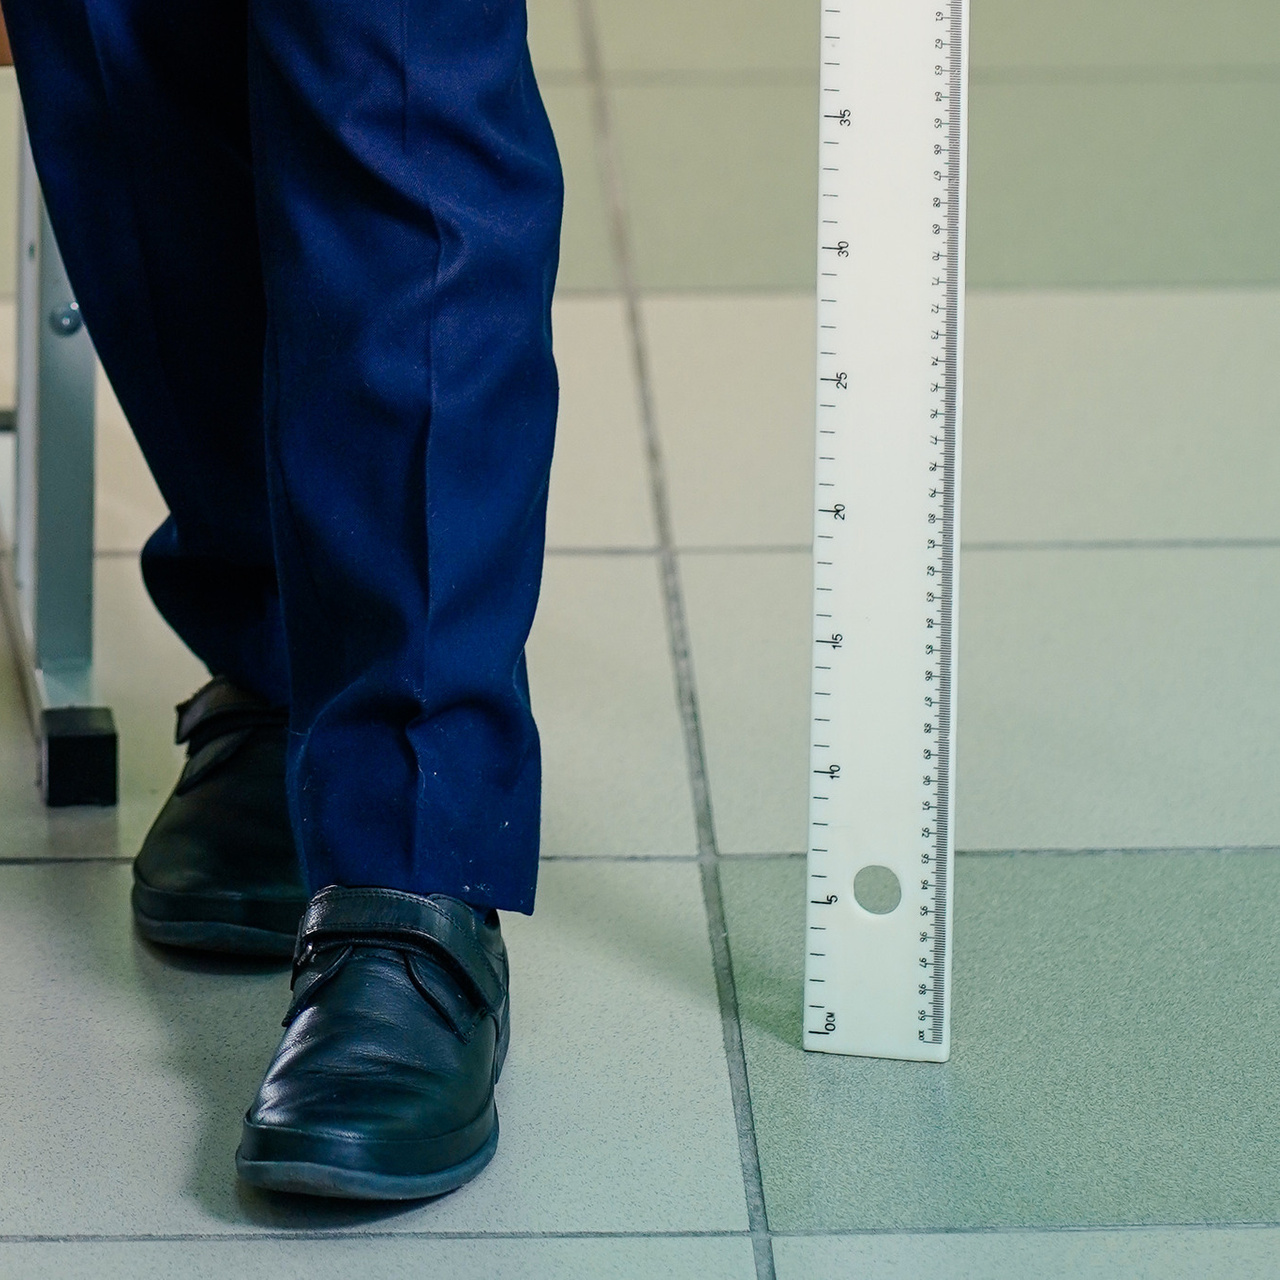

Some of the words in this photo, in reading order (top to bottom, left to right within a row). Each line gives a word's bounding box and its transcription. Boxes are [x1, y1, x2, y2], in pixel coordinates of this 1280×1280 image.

[935, 11, 943, 21] 61
[935, 38, 942, 49] 62
[935, 65, 942, 76] 63
[935, 91, 942, 102] 64
[840, 109, 851, 126] 35
[934, 118, 942, 129] 65
[934, 144, 941, 155] 66
[934, 170, 941, 181] 67
[933, 197, 940, 208] 68
[933, 224, 940, 235] 69
[838, 241, 849, 257] 30
[932, 251, 939, 261] 70
[931, 277, 939, 287] 71
[931, 304, 939, 314] 72
[931, 330, 938, 340] 73
[931, 357, 938, 366] 74
[836, 372, 847, 389] 25
[930, 383, 938, 393] 75
[930, 409, 937, 419] 76
[929, 462, 936, 472] 78
[929, 488, 936, 498] 79
[834, 504, 845, 520] 20
[928, 513, 935, 524] 80
[927, 539, 935, 549] 81
[927, 566, 934, 576] 82
[926, 592, 933, 602] 83
[926, 618, 933, 628] 84
[832, 634, 843, 649] 15
[926, 644, 933, 655] 85
[925, 670, 932, 681] 86
[925, 696, 932, 707] 87
[924, 723, 931, 734] 88
[924, 749, 931, 760] 89
[829, 765, 840, 779] 10
[923, 775, 930, 786] 90
[922, 801, 930, 811] 91
[922, 827, 929, 838] 92
[921, 853, 929, 864] 93
[921, 880, 928, 890] 94
[827, 895, 838, 903] 5
[920, 906, 927, 916] 95
[920, 932, 927, 942] 96
[919, 957, 926, 968] 97
[919, 984, 926, 995] 98
[918, 1010, 925, 1021] 99
